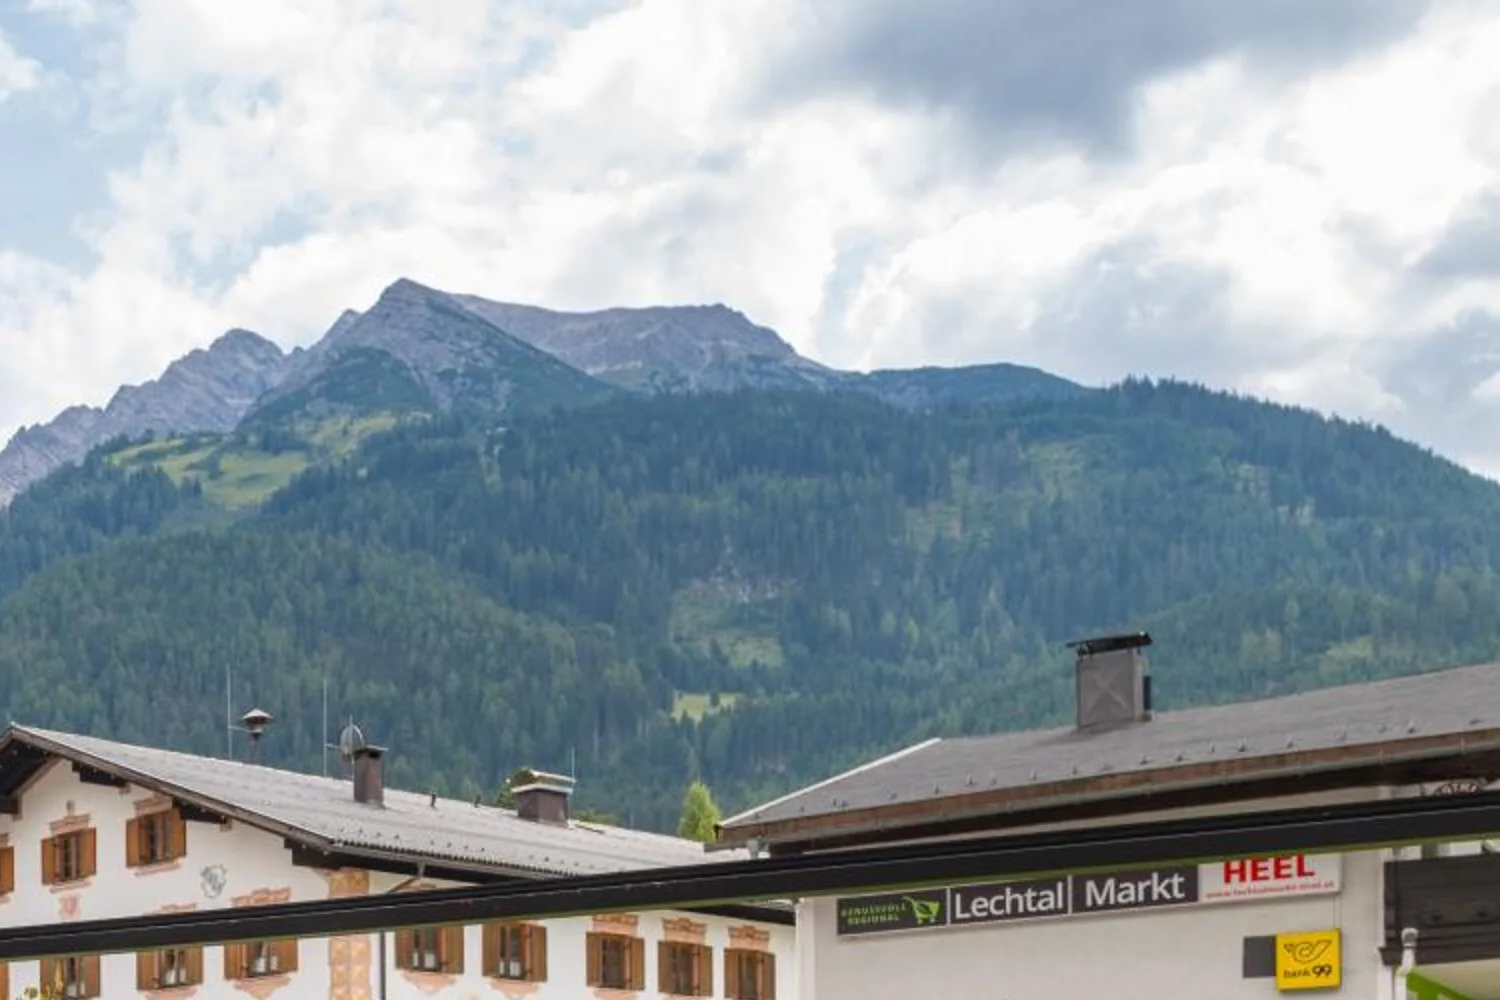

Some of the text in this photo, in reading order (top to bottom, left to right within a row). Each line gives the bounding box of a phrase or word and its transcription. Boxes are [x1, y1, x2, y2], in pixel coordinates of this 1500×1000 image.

[1223, 853, 1315, 885] HEEL
[955, 872, 1185, 919] Lechtal Markt
[1312, 963, 1333, 978] 99
